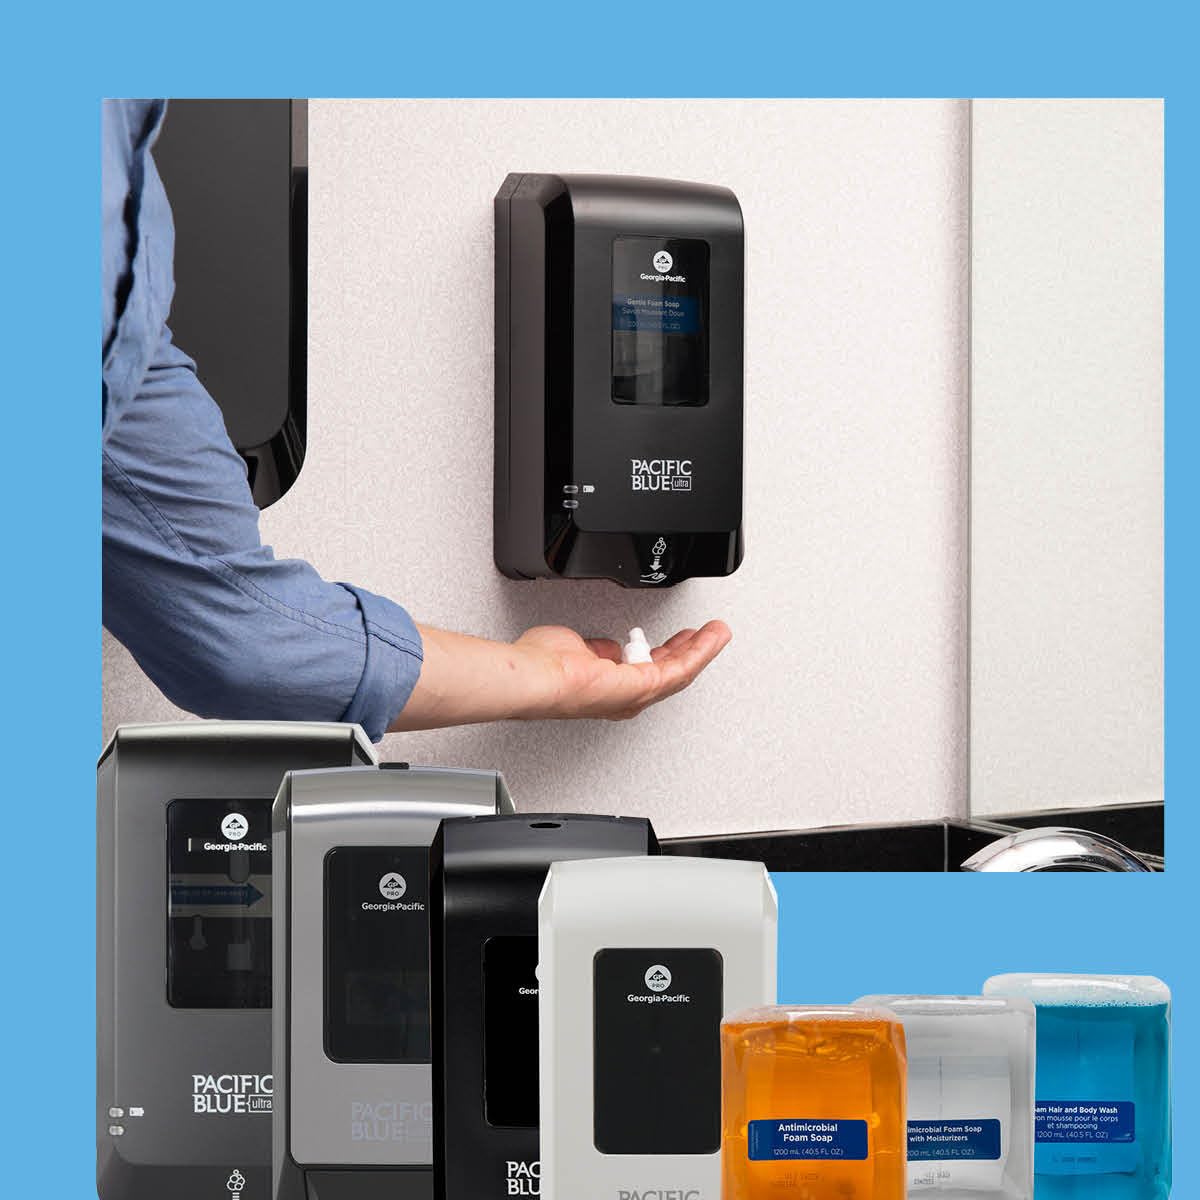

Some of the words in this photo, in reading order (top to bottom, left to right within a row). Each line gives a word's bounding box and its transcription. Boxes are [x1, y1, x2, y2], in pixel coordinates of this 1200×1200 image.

[631, 460, 692, 475] PACIFIC
[631, 475, 670, 491] BLUE
[674, 479, 689, 488] ultra
[204, 842, 268, 852] Georgia-Pacific
[361, 902, 425, 912] Georgia-Pacific
[627, 994, 690, 1004] Georgia-Pacific
[192, 1074, 273, 1094] PACIFIC
[192, 1094, 246, 1113] BLUE
[252, 1098, 272, 1109] ultra
[1080, 1106, 1098, 1115] Body
[1099, 1106, 1118, 1114] Wash
[1100, 1115, 1119, 1123] corps
[778, 1123, 838, 1132] Antimicrobial
[943, 1125, 963, 1133] Foam
[964, 1125, 983, 1134] Soap
[1056, 1122, 1098, 1130] shampooing
[783, 1133, 808, 1142] Foam
[810, 1133, 833, 1143] Soap
[927, 1134, 968, 1142] Moisturizers
[831, 1148, 844, 1156] OZ)
